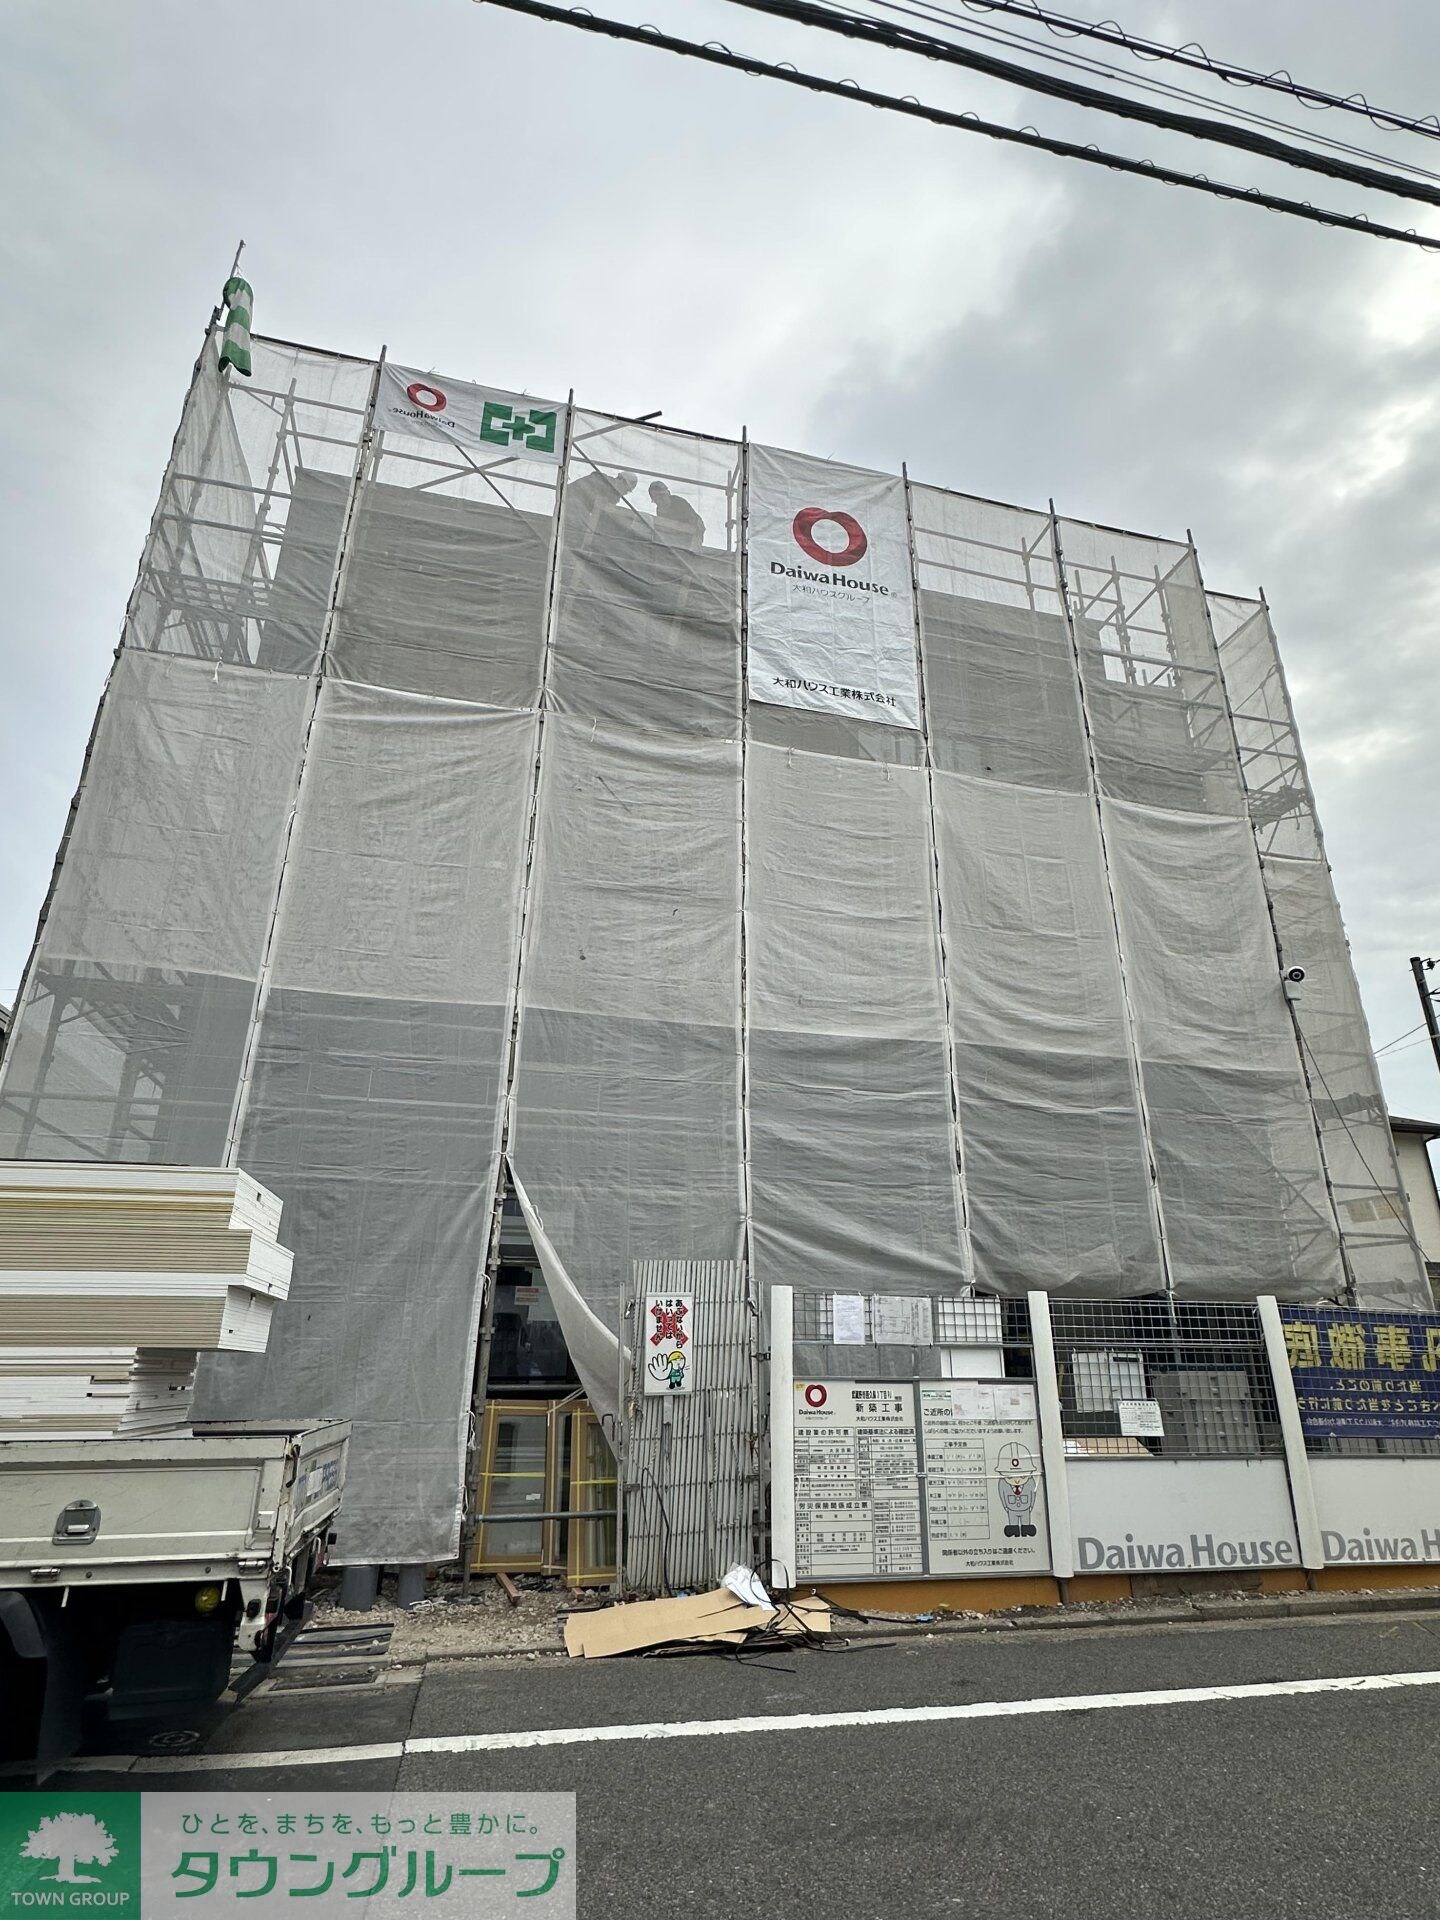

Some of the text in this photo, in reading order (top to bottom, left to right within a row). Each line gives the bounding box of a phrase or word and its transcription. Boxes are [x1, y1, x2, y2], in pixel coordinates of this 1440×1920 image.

[773, 677, 896, 707] 大和ハウス工業株式会社
[655, 1299, 663, 1341] いけません
[665, 1299, 673, 1340] はいっては
[675, 1299, 683, 1349] あぶないから
[855, 1403, 903, 1413] 新築工事
[923, 1408, 953, 1417] ご近所の
[798, 1501, 869, 1510] 労災保険関係成立票
